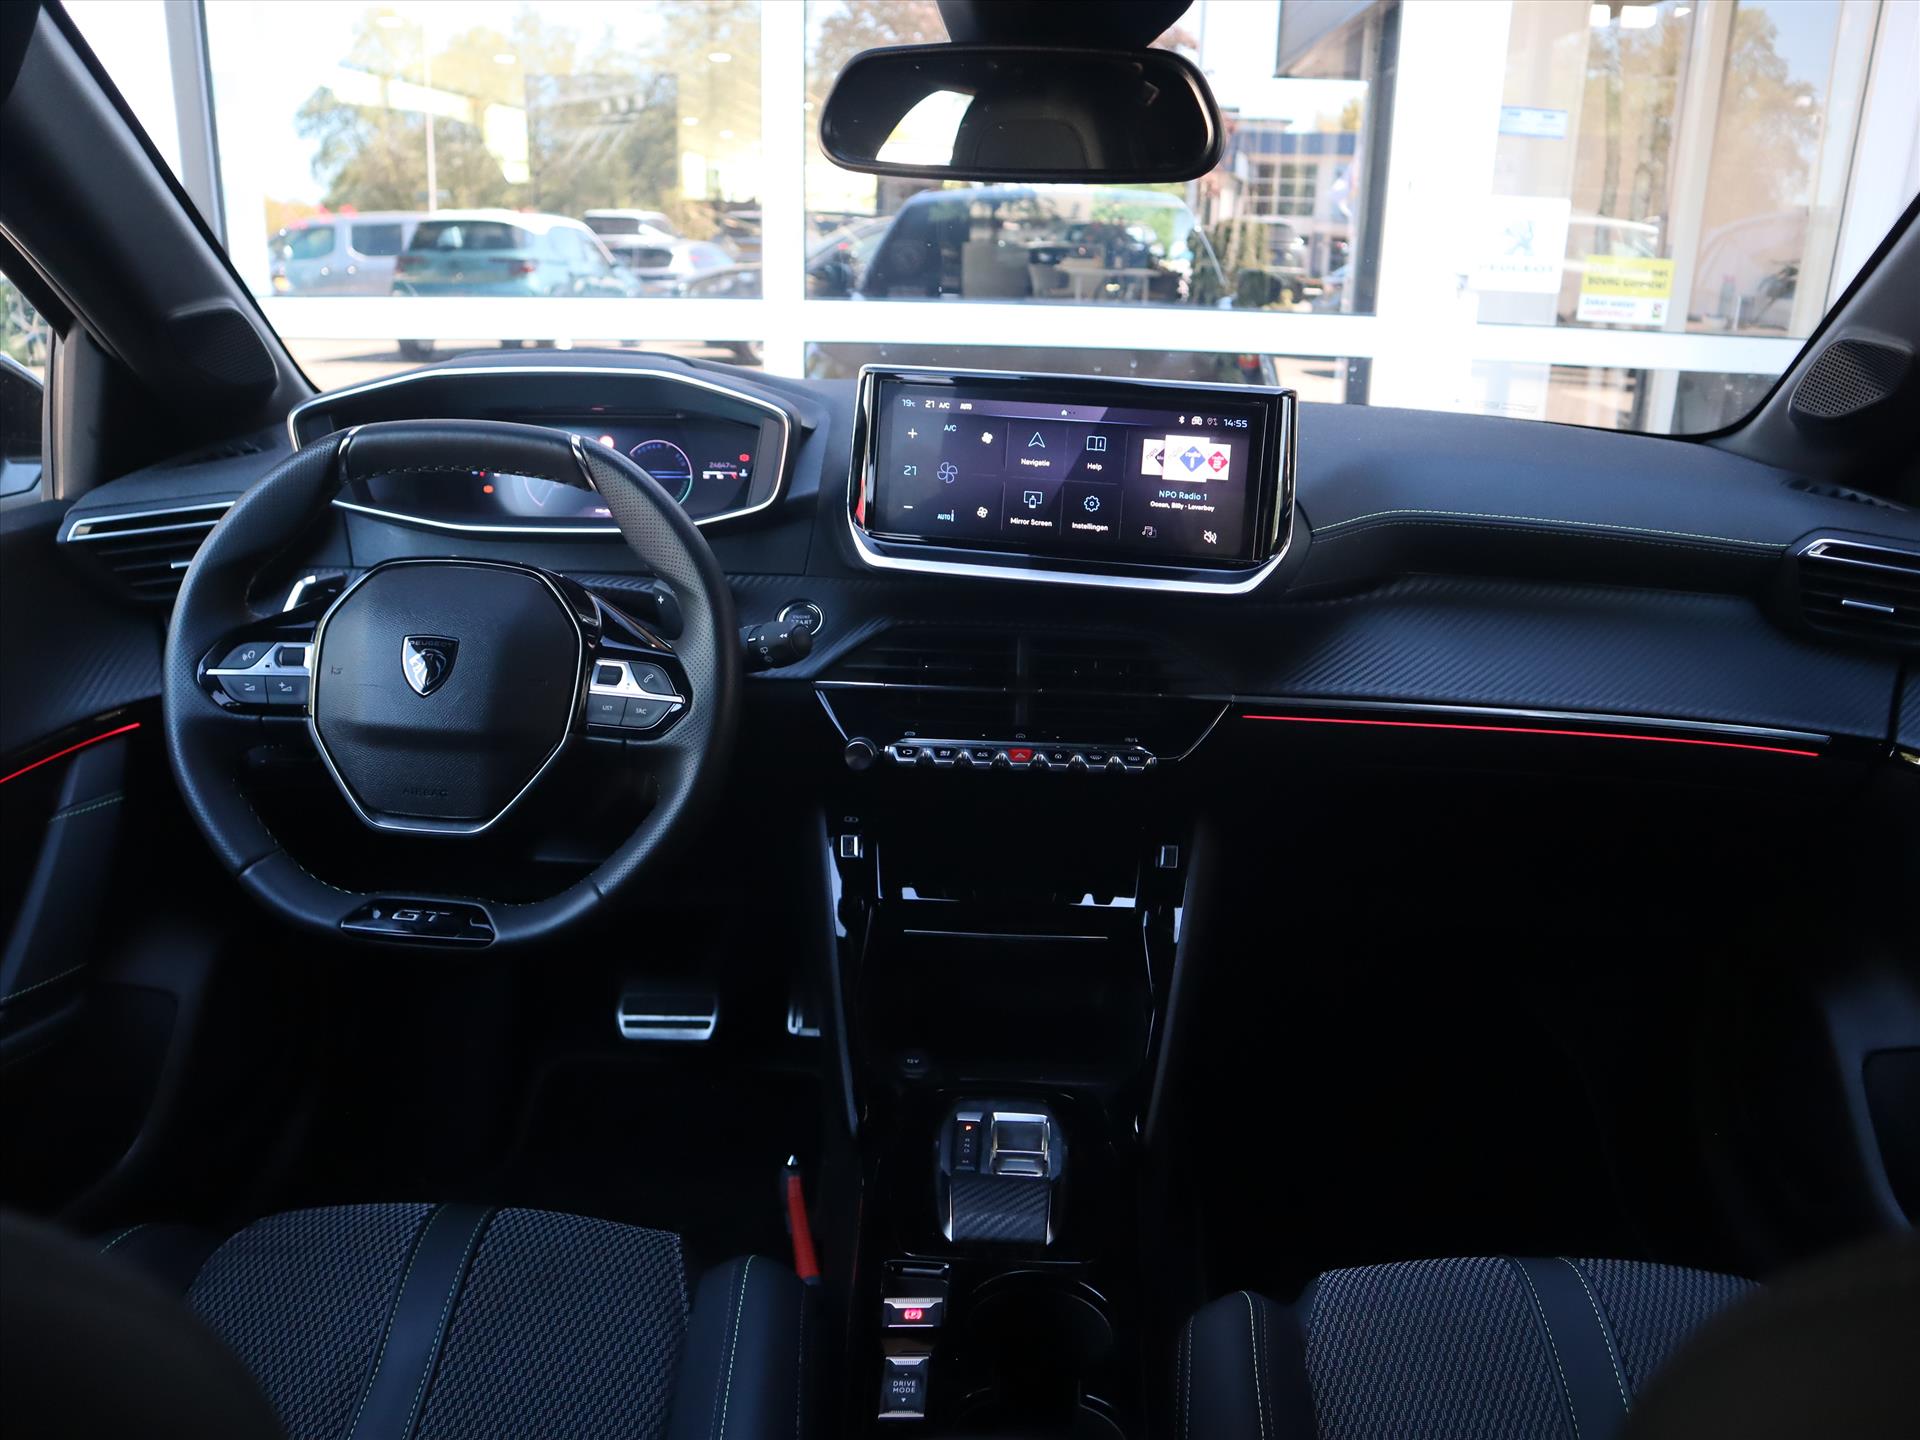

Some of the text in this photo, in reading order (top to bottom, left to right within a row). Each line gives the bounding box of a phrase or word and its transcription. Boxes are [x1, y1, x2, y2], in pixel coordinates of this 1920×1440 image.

[925, 400, 935, 408] 21
[944, 424, 957, 432] A/C
[1224, 418, 1248, 428] 14:55
[1020, 458, 1050, 467] Navigatie
[1087, 462, 1102, 471] Help
[903, 465, 917, 476] 21
[1159, 490, 1177, 499] NPO
[1179, 491, 1201, 500] Radio
[1150, 501, 1170, 509] Ocean,
[1171, 502, 1184, 510] Billy
[1187, 503, 1215, 512] Loverboy
[1010, 517, 1053, 527] Mirror Screen
[1072, 522, 1109, 532] Instellingen
[409, 640, 457, 648] PEUGEOT
[391, 909, 452, 922] GT
